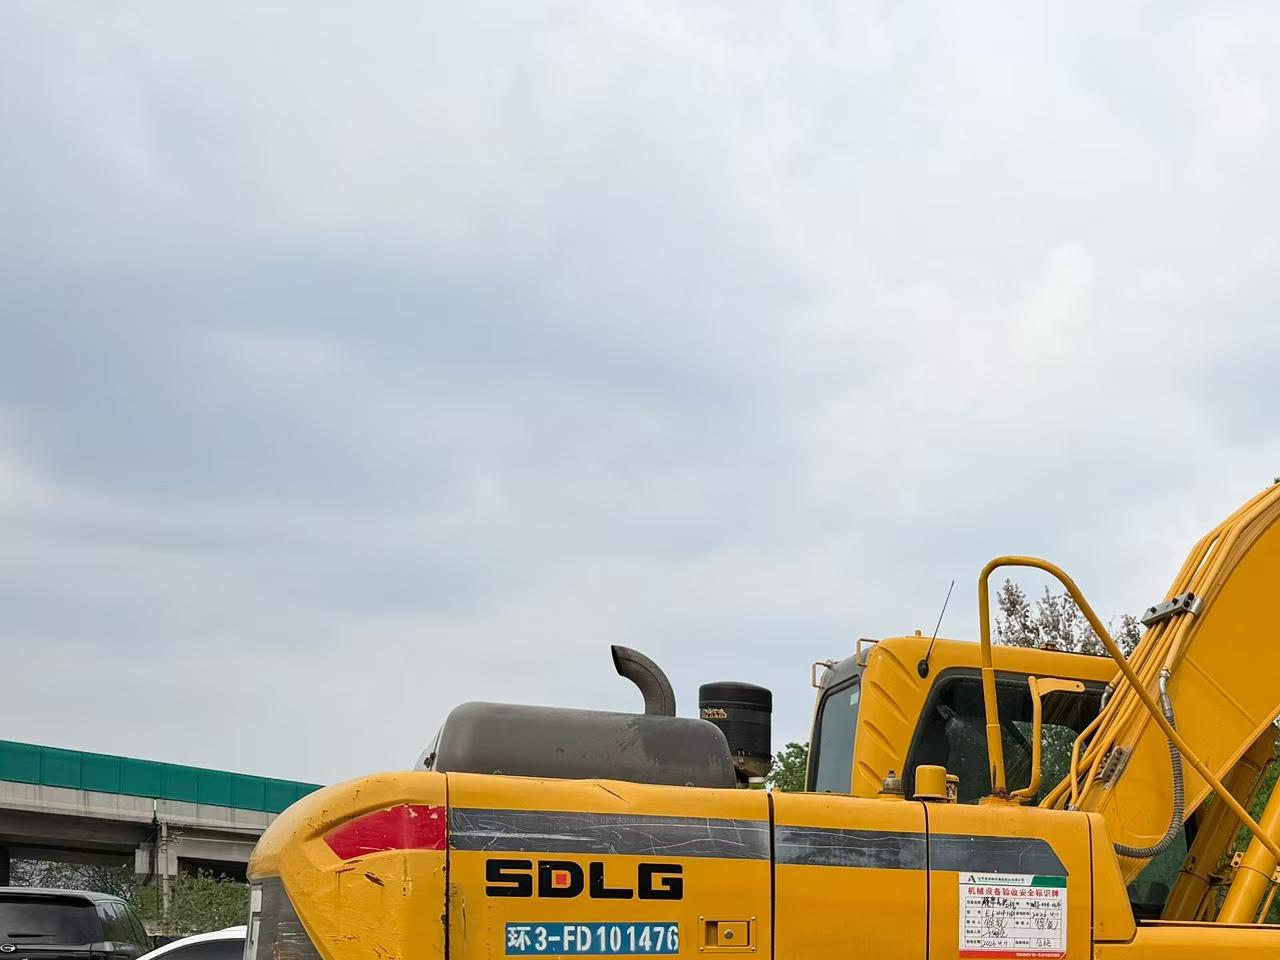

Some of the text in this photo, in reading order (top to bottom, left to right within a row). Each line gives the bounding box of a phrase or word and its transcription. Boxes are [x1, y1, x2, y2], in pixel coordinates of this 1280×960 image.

[485, 859, 684, 900] SDLG
[968, 886, 1060, 898] 机械设备验收安全标识牌
